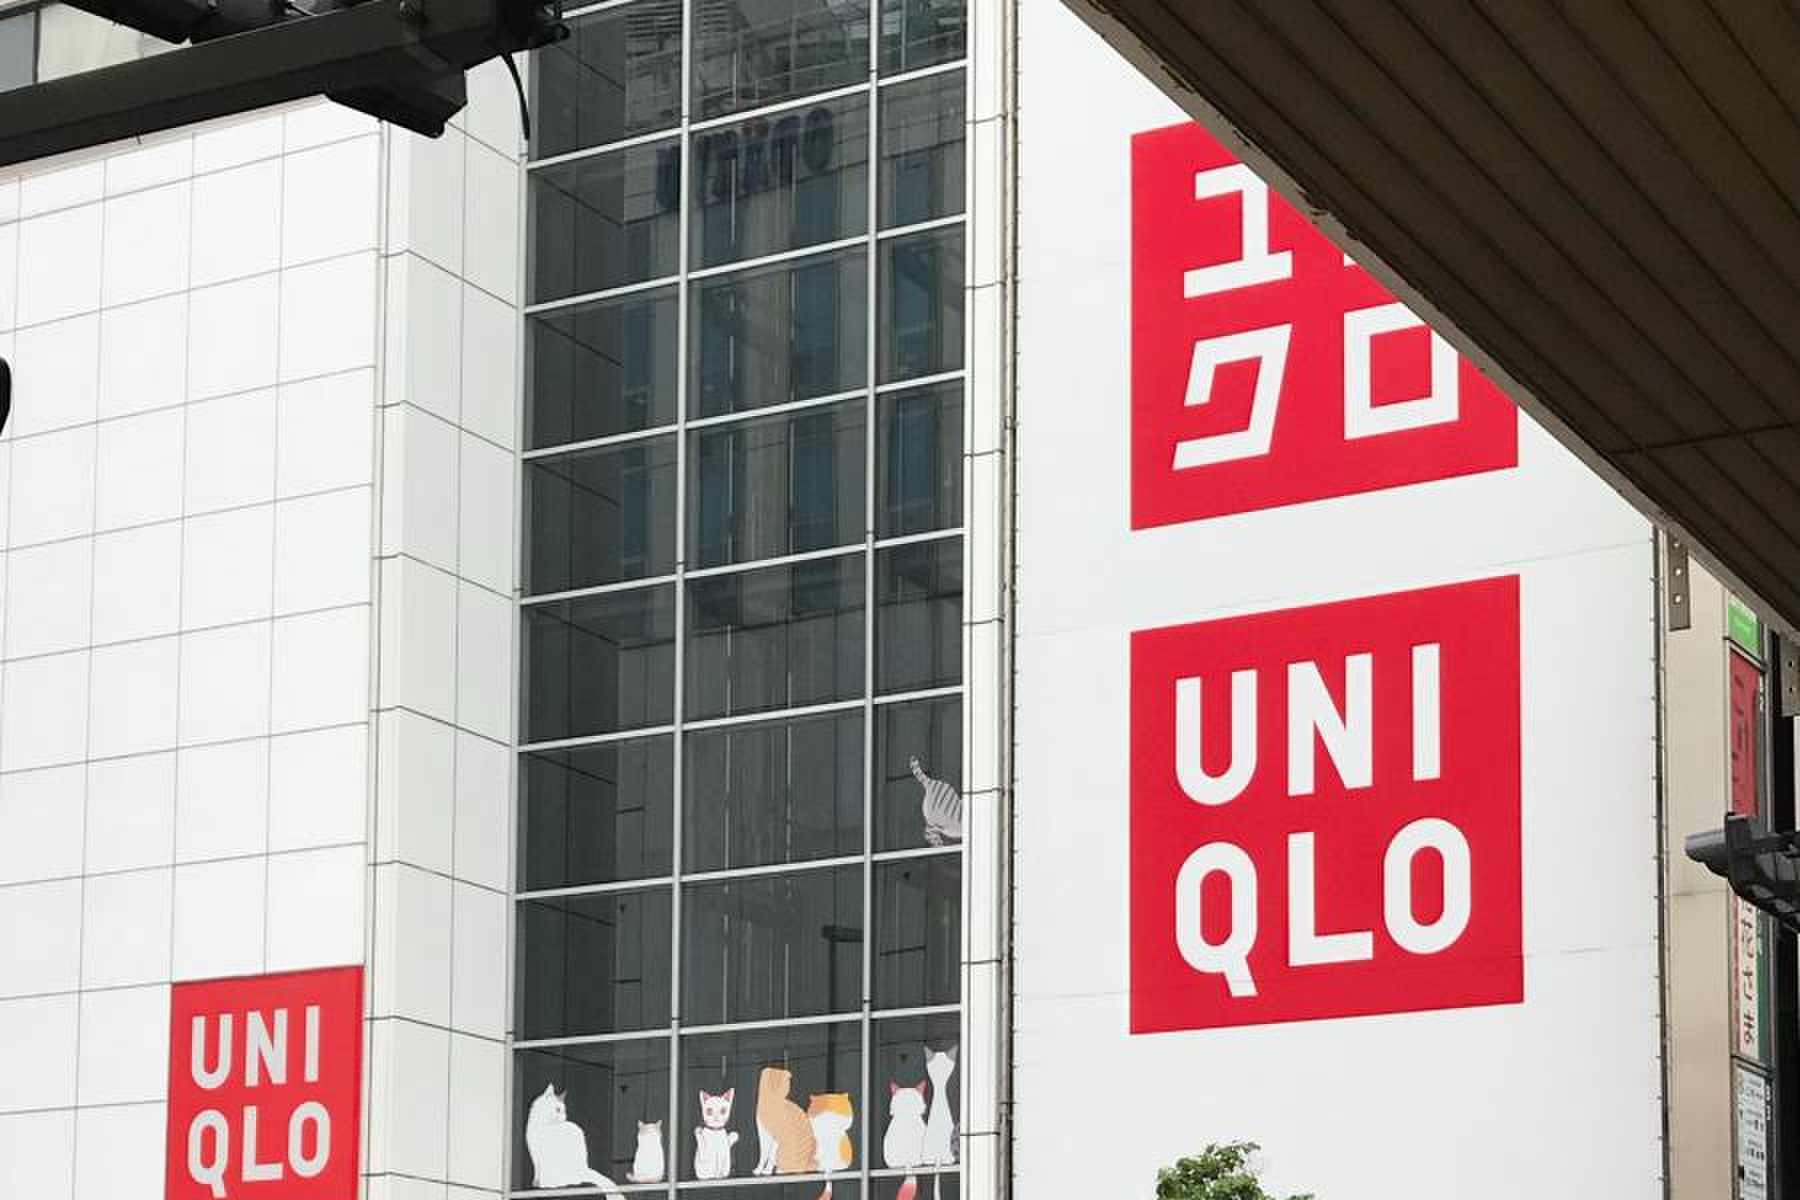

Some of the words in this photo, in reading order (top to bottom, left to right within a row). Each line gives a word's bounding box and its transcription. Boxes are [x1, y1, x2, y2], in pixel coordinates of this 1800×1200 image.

[1175, 643, 1440, 805] UNI
[1175, 817, 1471, 998] QLO
[191, 1005, 321, 1090] UNI
[187, 1101, 332, 1199] QLO
